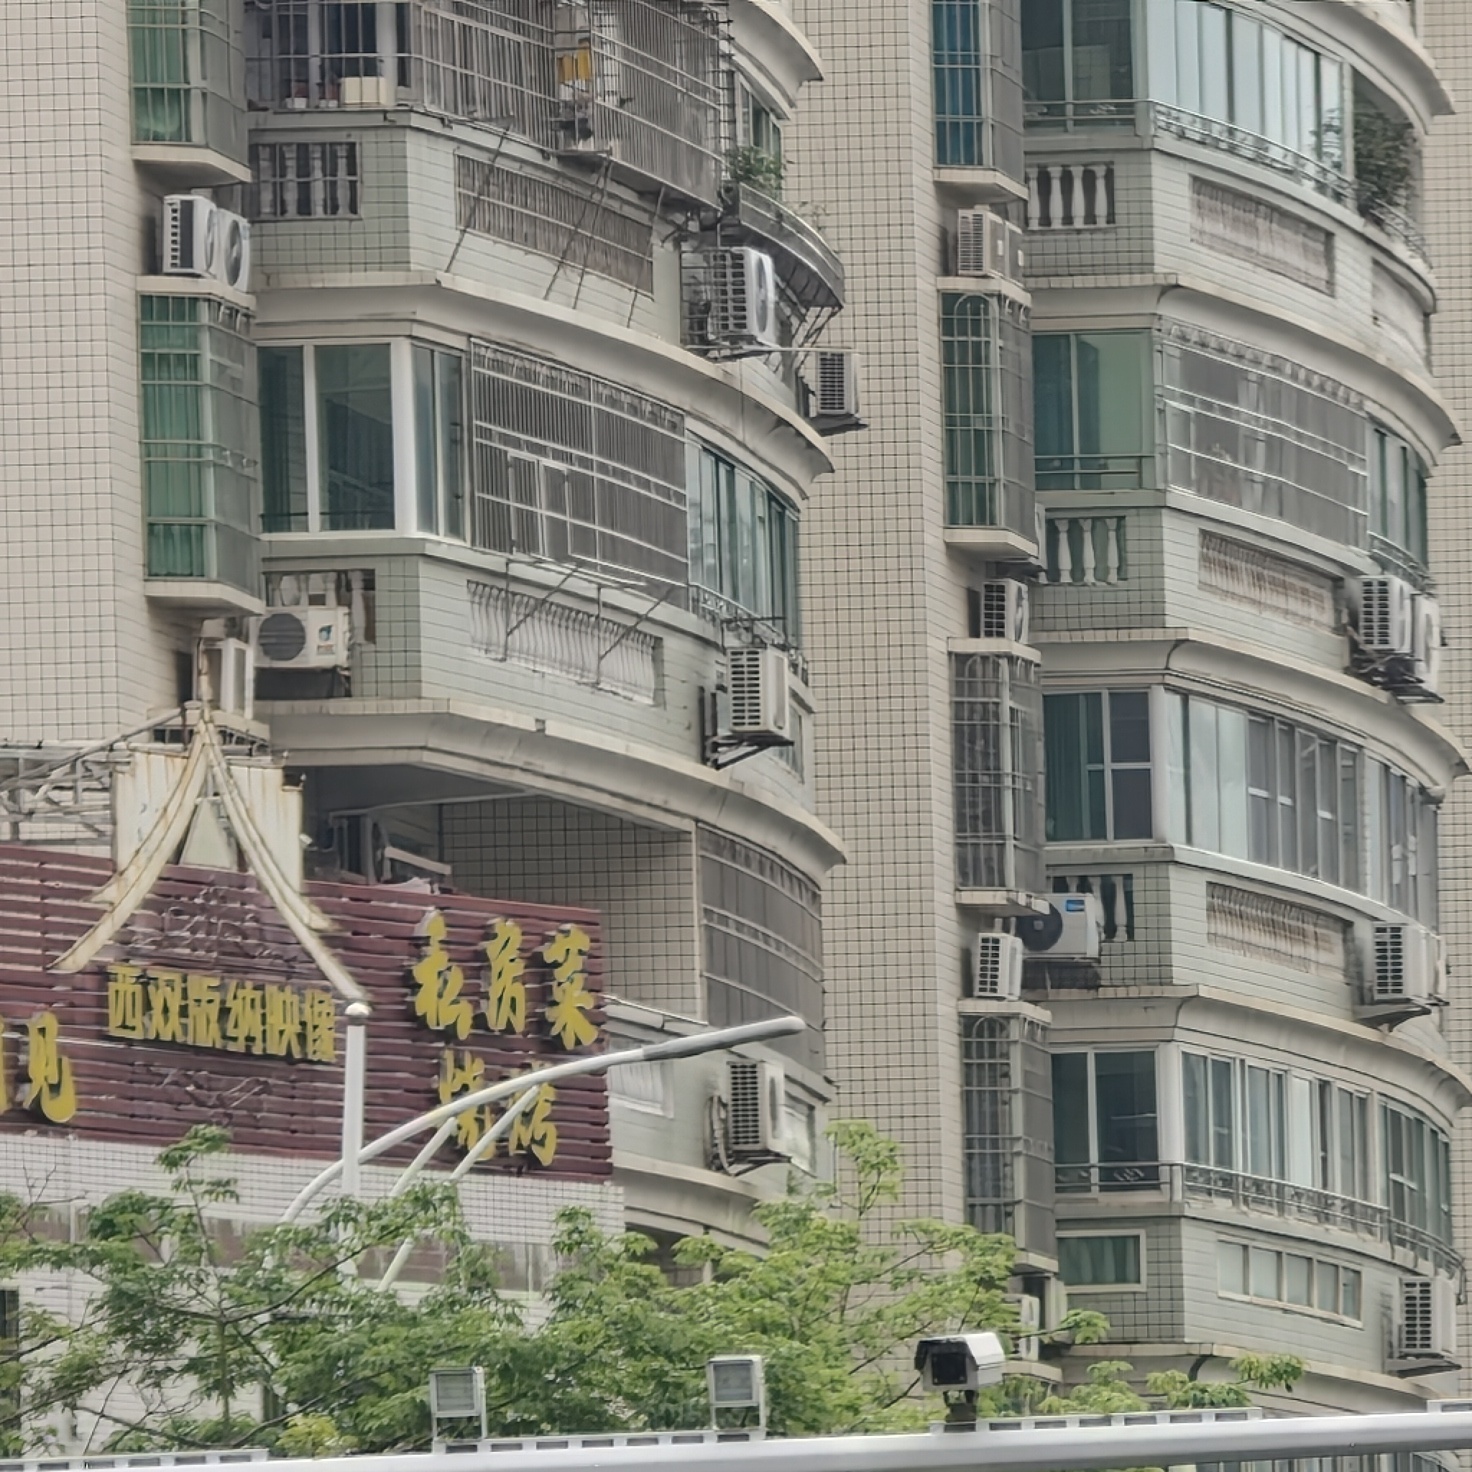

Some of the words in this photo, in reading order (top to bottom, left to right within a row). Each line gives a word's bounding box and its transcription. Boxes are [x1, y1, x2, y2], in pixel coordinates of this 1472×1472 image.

[106, 963, 337, 1063] 西双版纳映像
[412, 912, 599, 1050] 私房菜
[0, 1010, 77, 1124] 见
